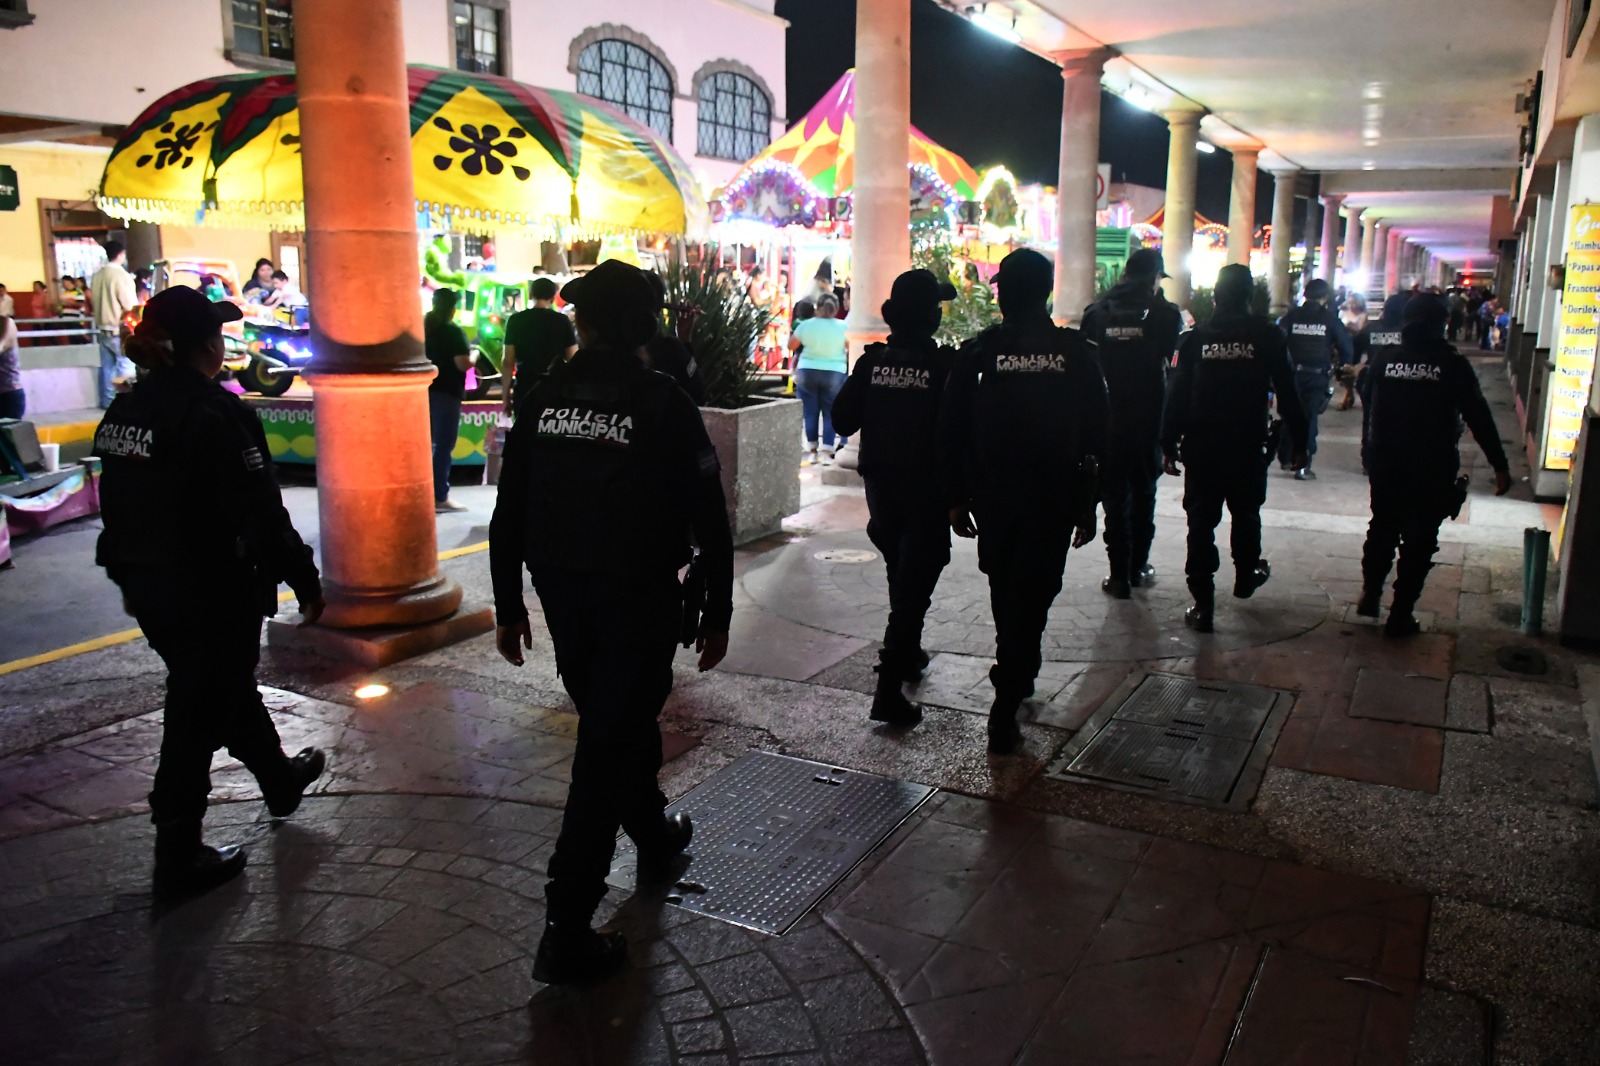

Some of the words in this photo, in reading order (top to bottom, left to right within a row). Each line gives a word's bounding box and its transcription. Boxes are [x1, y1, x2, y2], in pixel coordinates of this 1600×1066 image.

[1572, 263, 1594, 273] Papas
[1202, 343, 1254, 351] POLICIA
[996, 354, 1065, 363] POLICIA
[872, 366, 930, 378] POLICIA
[996, 360, 1065, 372] MUNICIPAL
[1386, 362, 1441, 373] POLICIA
[1384, 369, 1440, 380] MUNICIPAL
[871, 375, 929, 388] MUNICIPAL
[540, 407, 633, 429] POLICIA
[99, 424, 153, 443] POLICIA
[537, 419, 630, 444] MUNICIPAL
